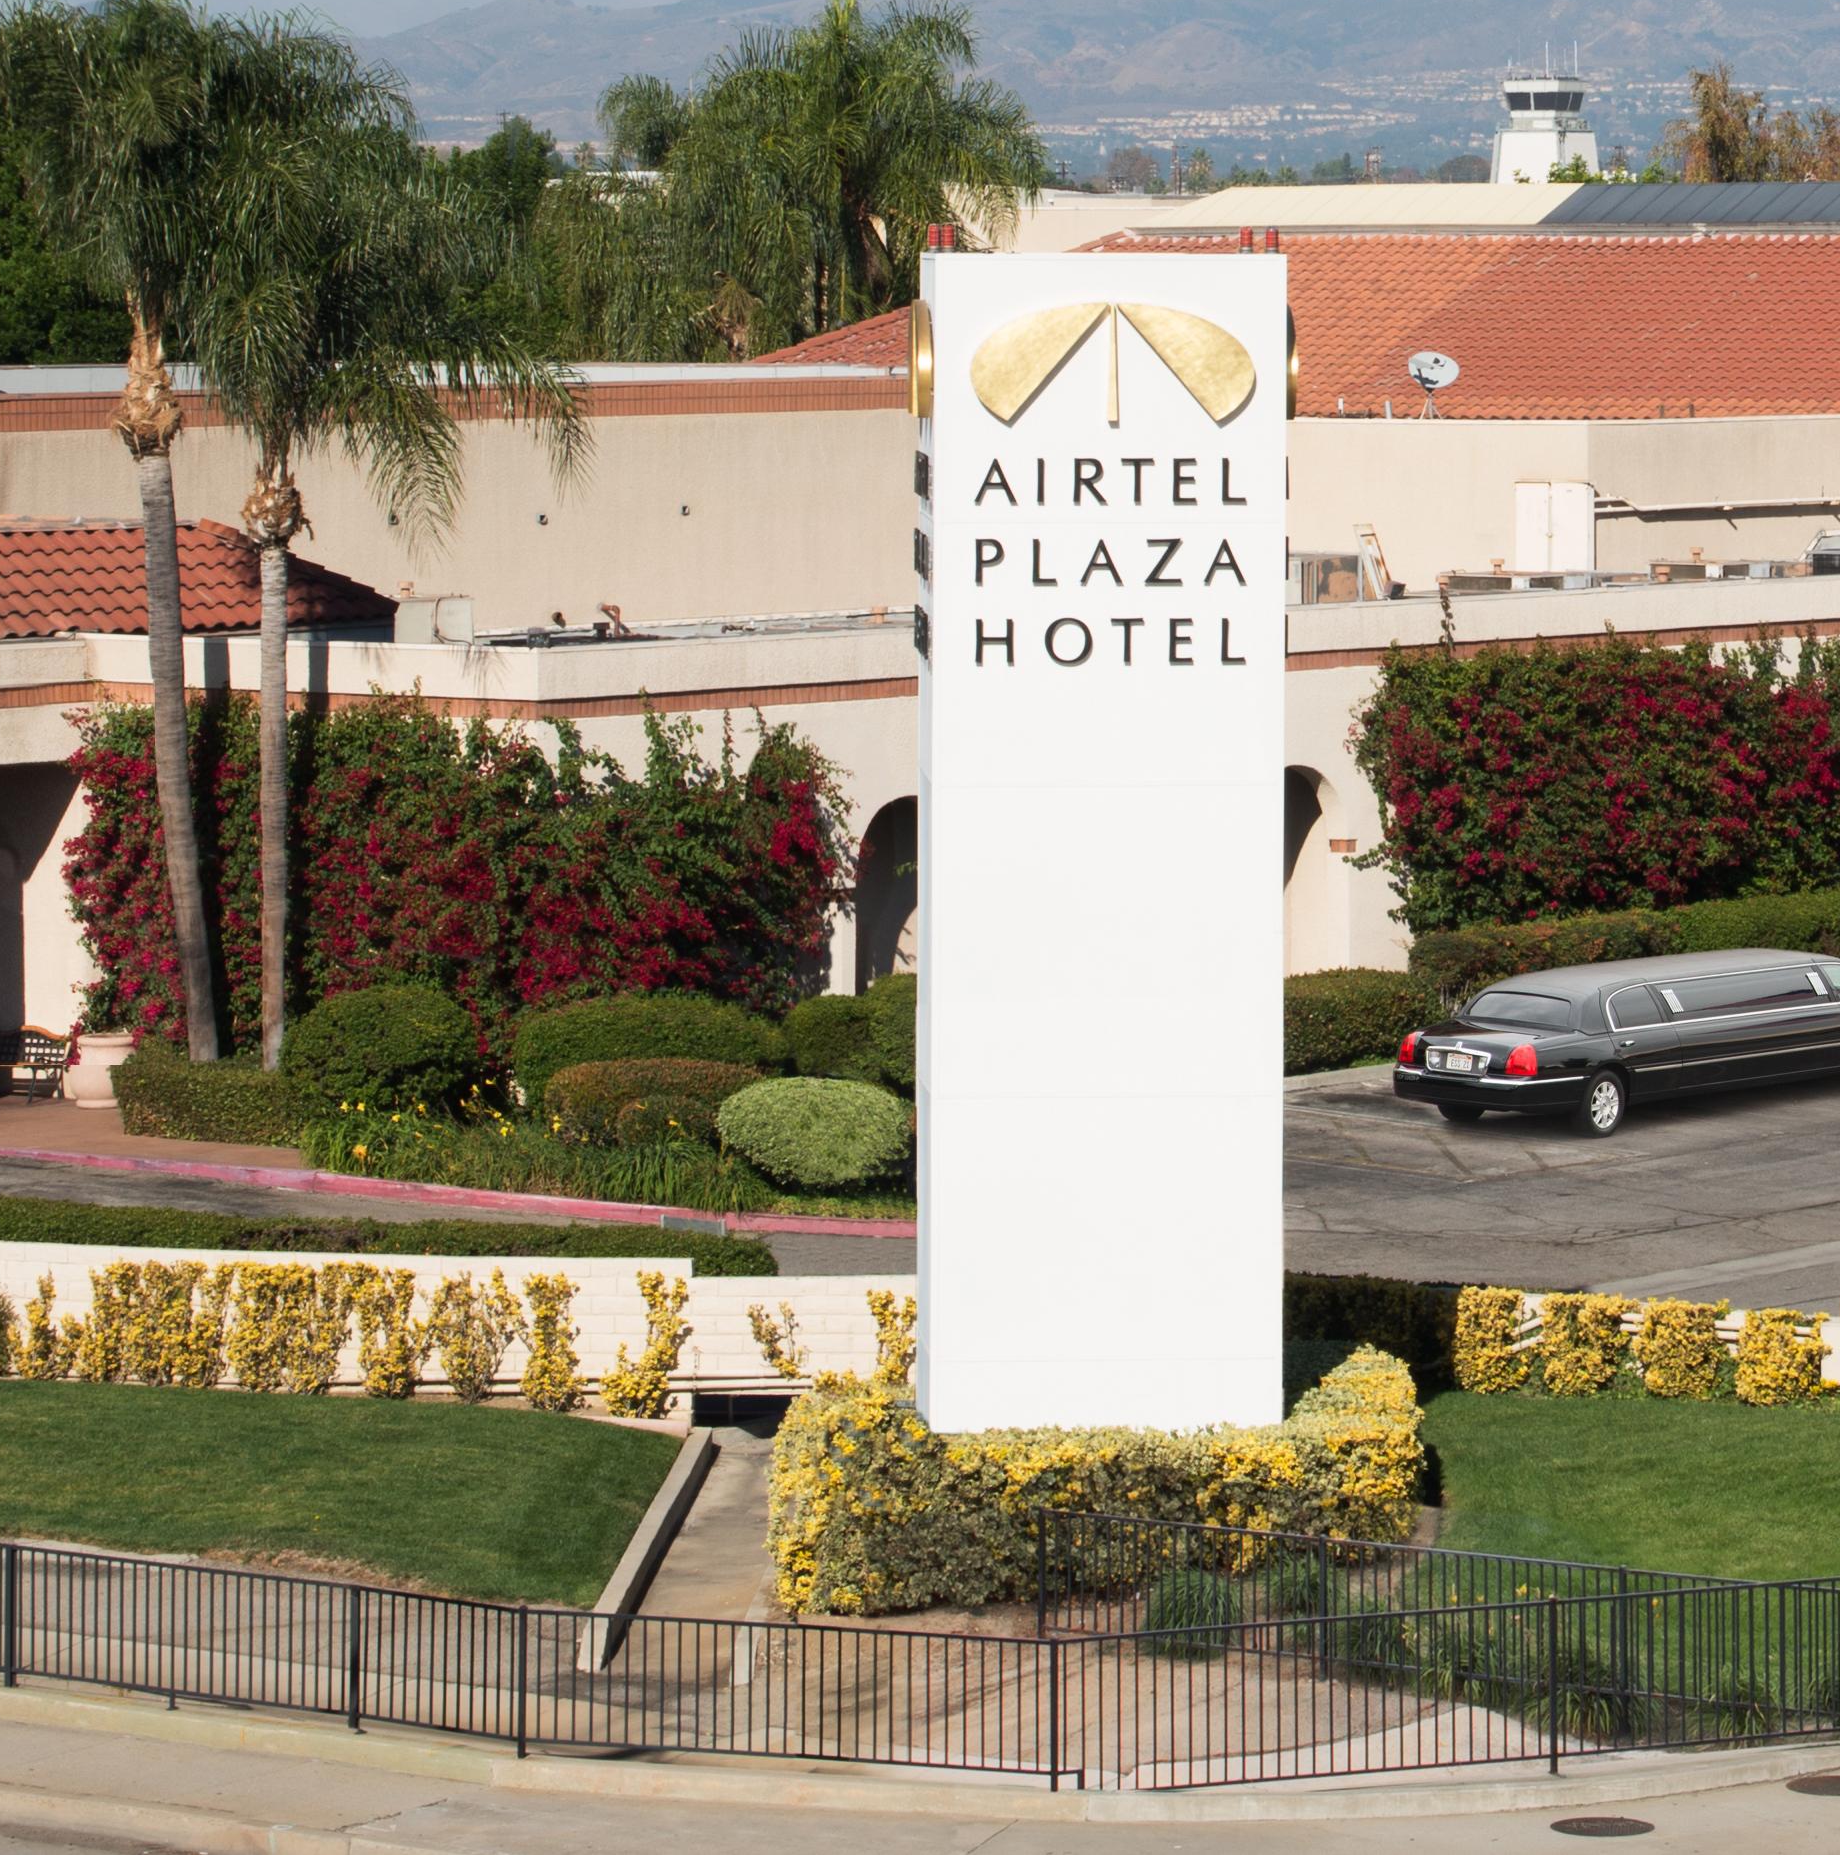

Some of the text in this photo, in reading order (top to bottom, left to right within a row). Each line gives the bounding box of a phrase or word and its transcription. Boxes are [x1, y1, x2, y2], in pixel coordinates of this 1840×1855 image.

[974, 458, 1248, 506] AIRTEL
[974, 538, 1247, 586] PLAZA
[974, 617, 1247, 667] HOTEL
